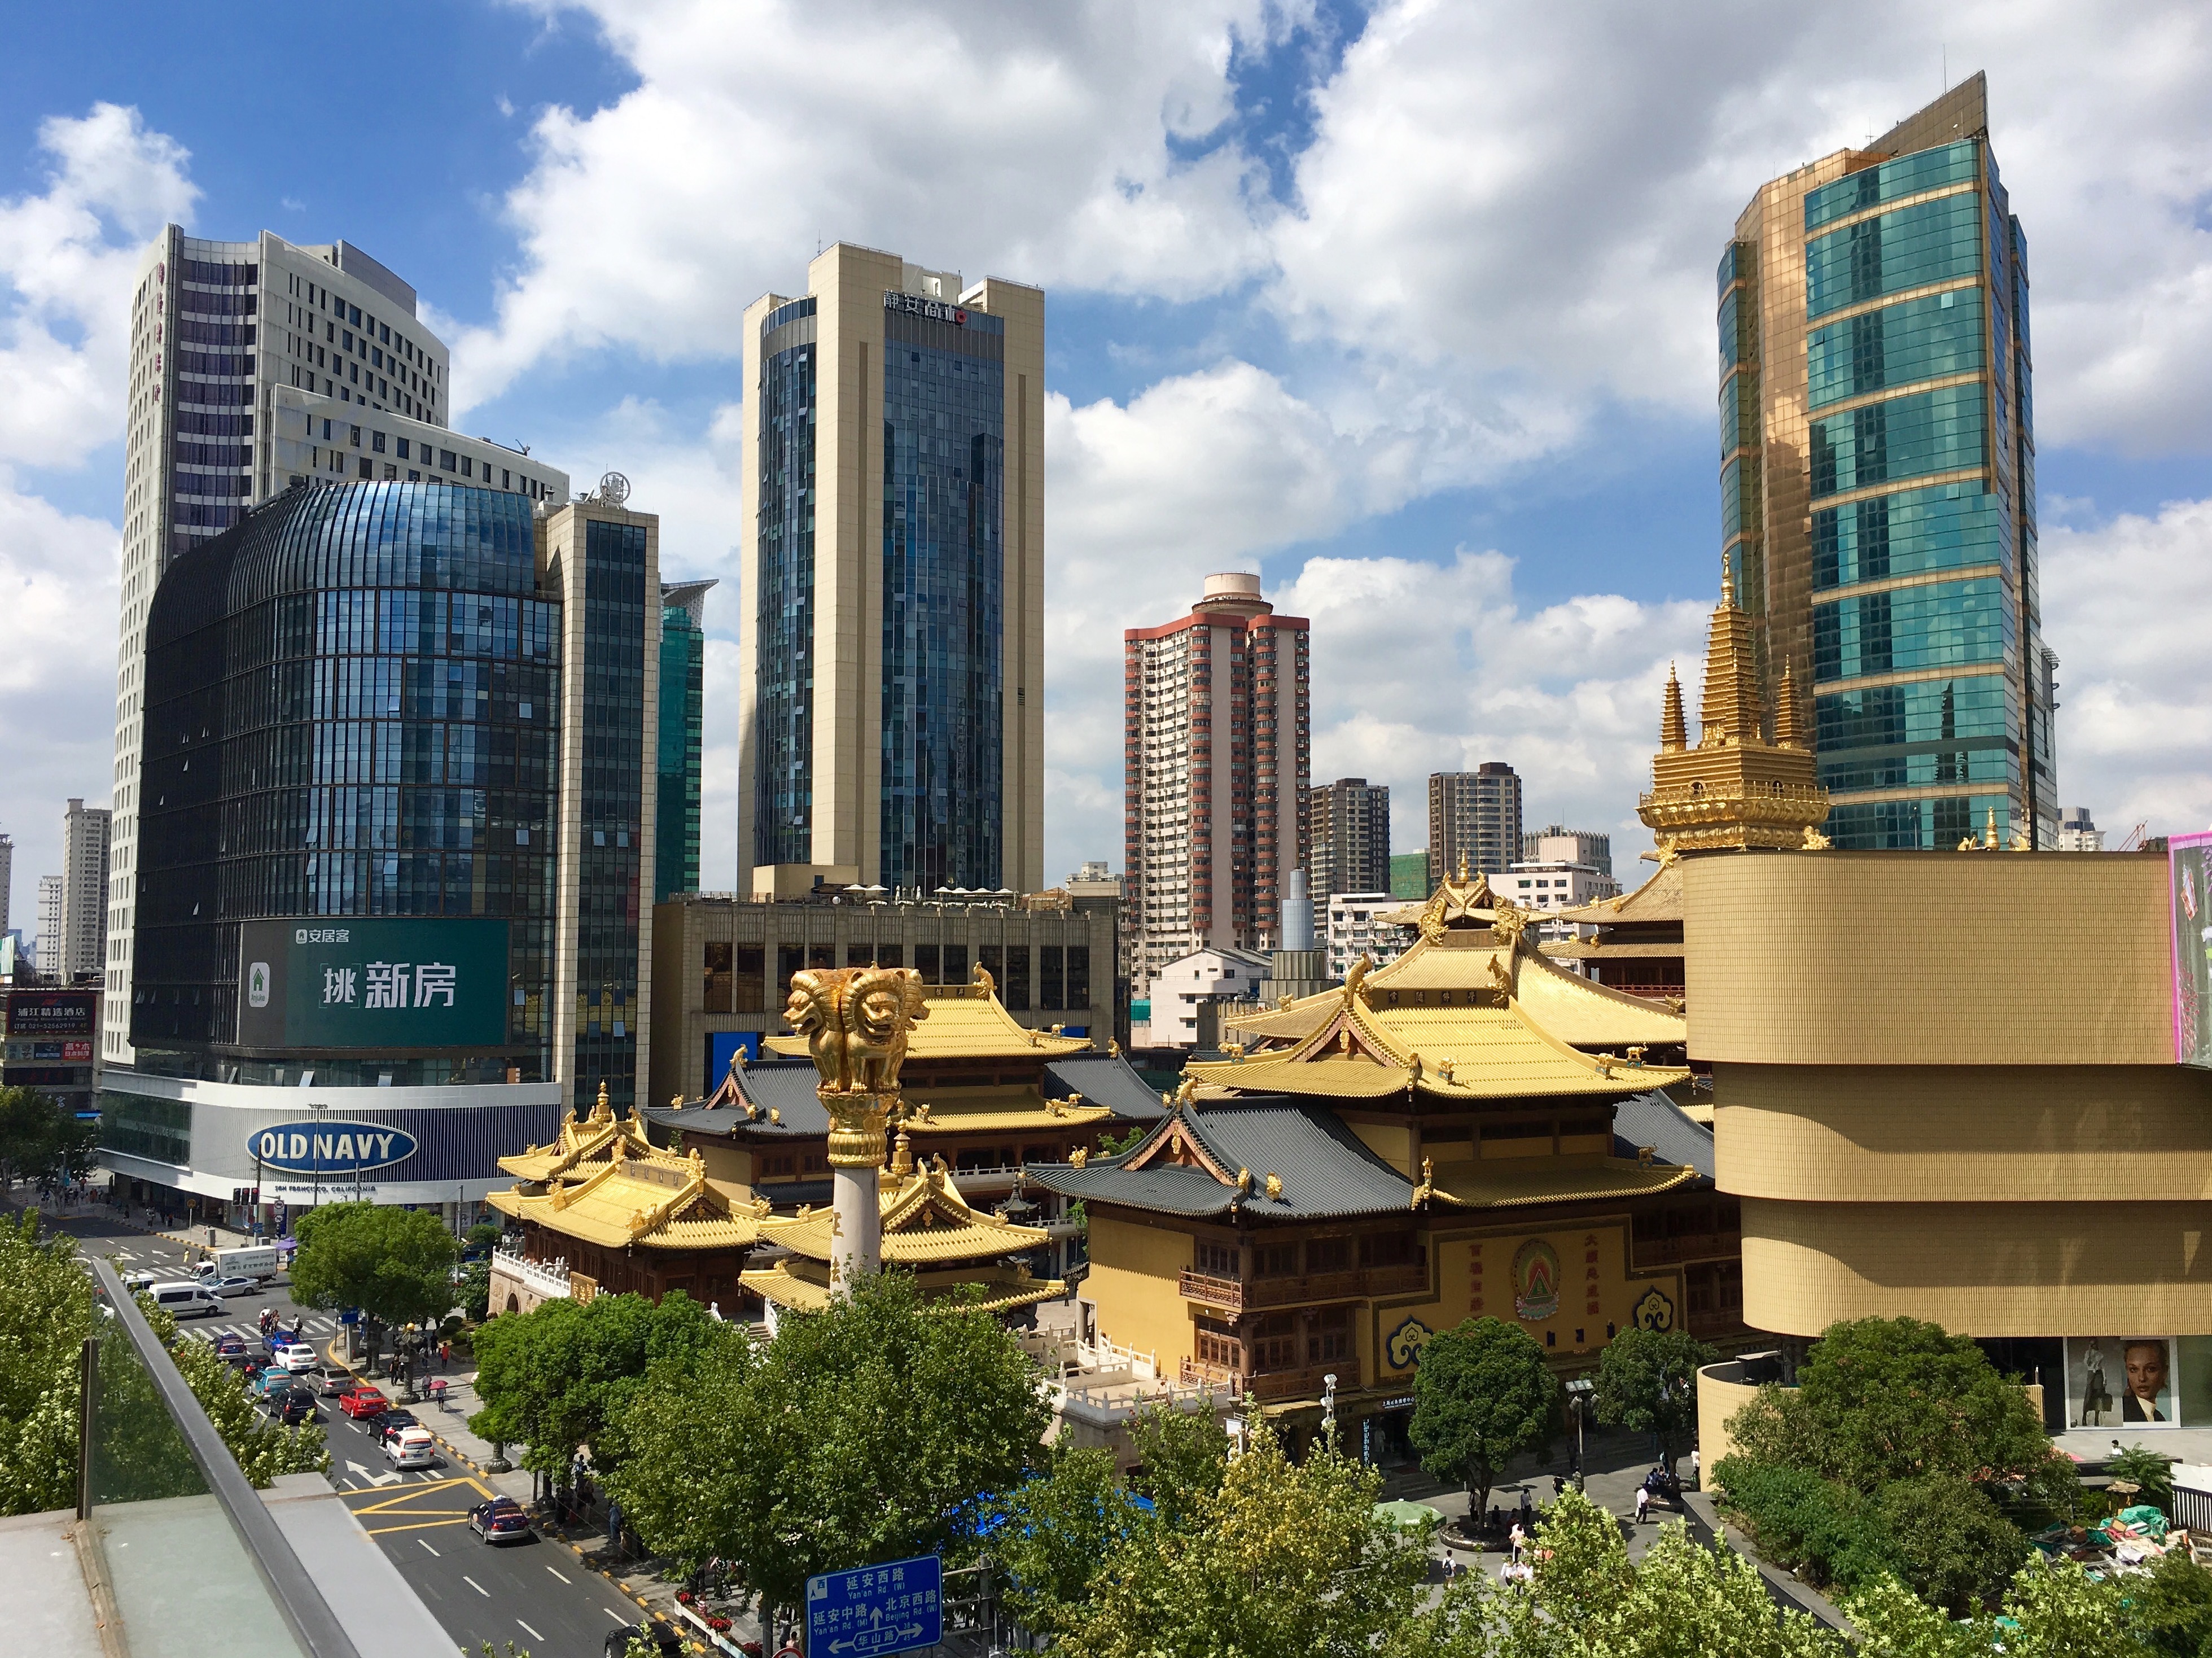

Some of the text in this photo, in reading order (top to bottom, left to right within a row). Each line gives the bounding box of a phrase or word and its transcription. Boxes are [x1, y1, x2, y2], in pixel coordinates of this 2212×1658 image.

[309, 929, 350, 943] 安居客
[323, 961, 455, 1008] 挑新房
[17, 1008, 86, 1017] 浦江精选酒店
[261, 1132, 395, 1160] OLD NAVY
[817, 1579, 825, 1589] 西
[846, 1567, 904, 1591] 延安西路
[848, 1589, 872, 1600] Yan'an
[894, 1582, 905, 1591] (W)
[886, 1589, 936, 1612] 北京西路
[813, 1603, 867, 1626] 延安中路
[886, 1611, 909, 1621] Beijing
[927, 1604, 938, 1613] (W)
[814, 1618, 868, 1636] Yan'an Rd. (M)
[858, 1630, 894, 1647] 华山路
